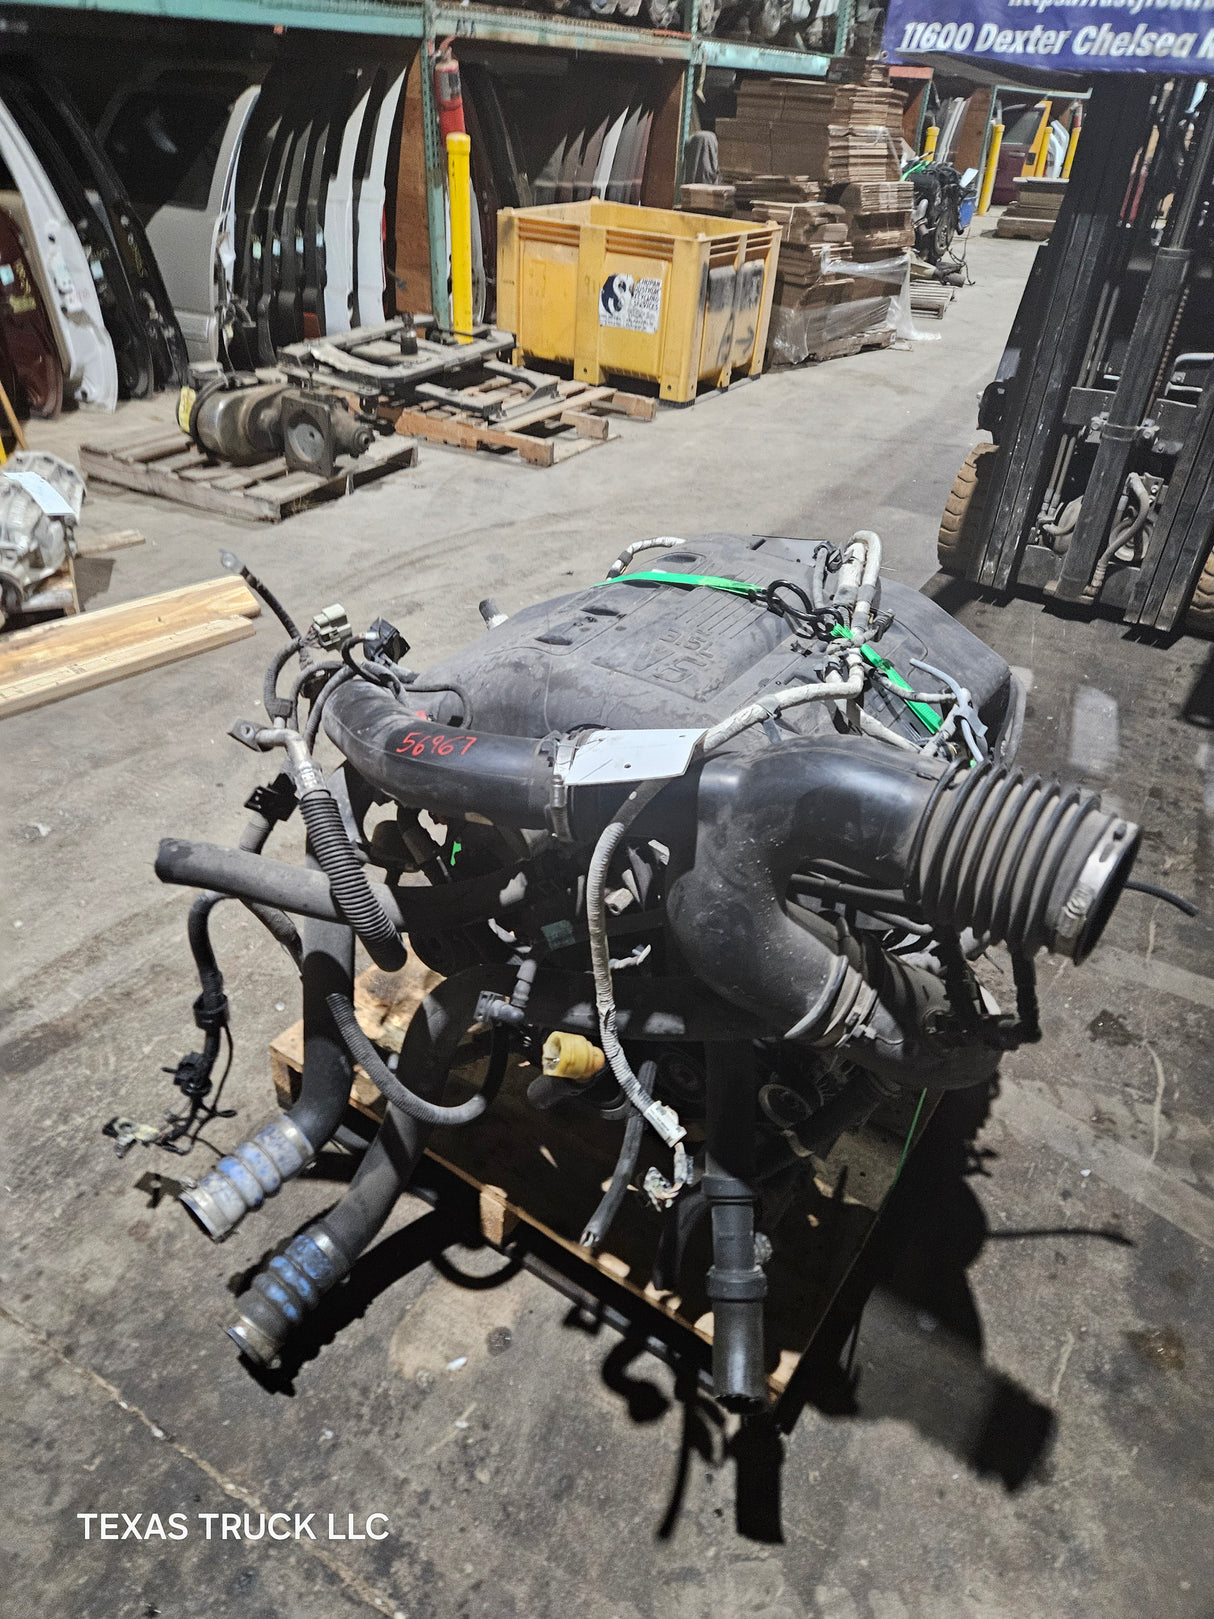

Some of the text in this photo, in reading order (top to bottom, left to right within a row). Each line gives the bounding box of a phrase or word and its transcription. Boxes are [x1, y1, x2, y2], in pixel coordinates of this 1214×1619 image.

[901, 22, 975, 51] 11600
[974, 24, 1072, 55] Dexter
[1072, 23, 1199, 58] Chelsea
[396, 732, 477, 756] 56967
